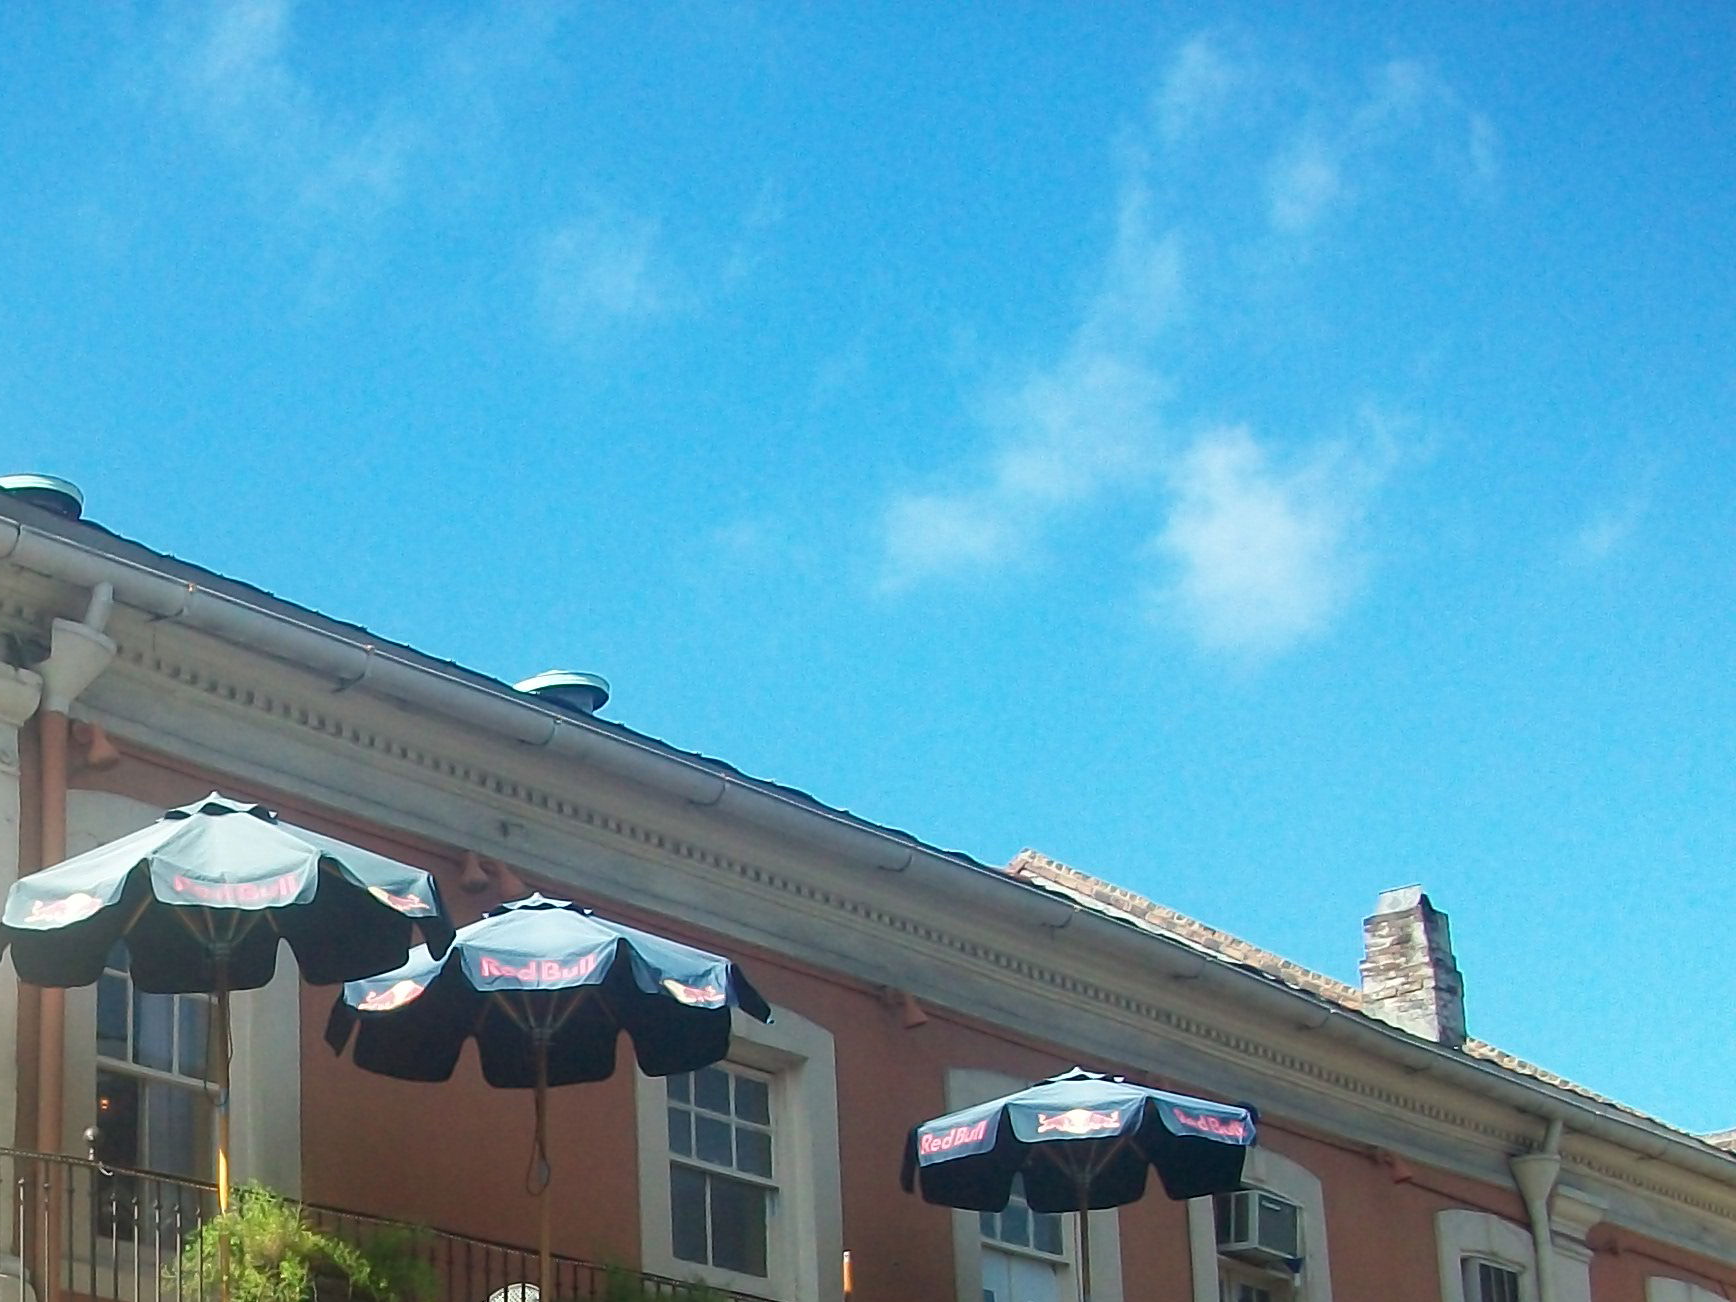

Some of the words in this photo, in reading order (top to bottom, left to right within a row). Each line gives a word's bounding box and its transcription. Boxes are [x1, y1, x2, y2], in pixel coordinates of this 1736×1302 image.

[242, 872, 300, 901] Bull
[479, 956, 538, 982] Red
[541, 953, 597, 980] Bull
[919, 1127, 954, 1155] Red
[954, 1119, 989, 1147] Bull
